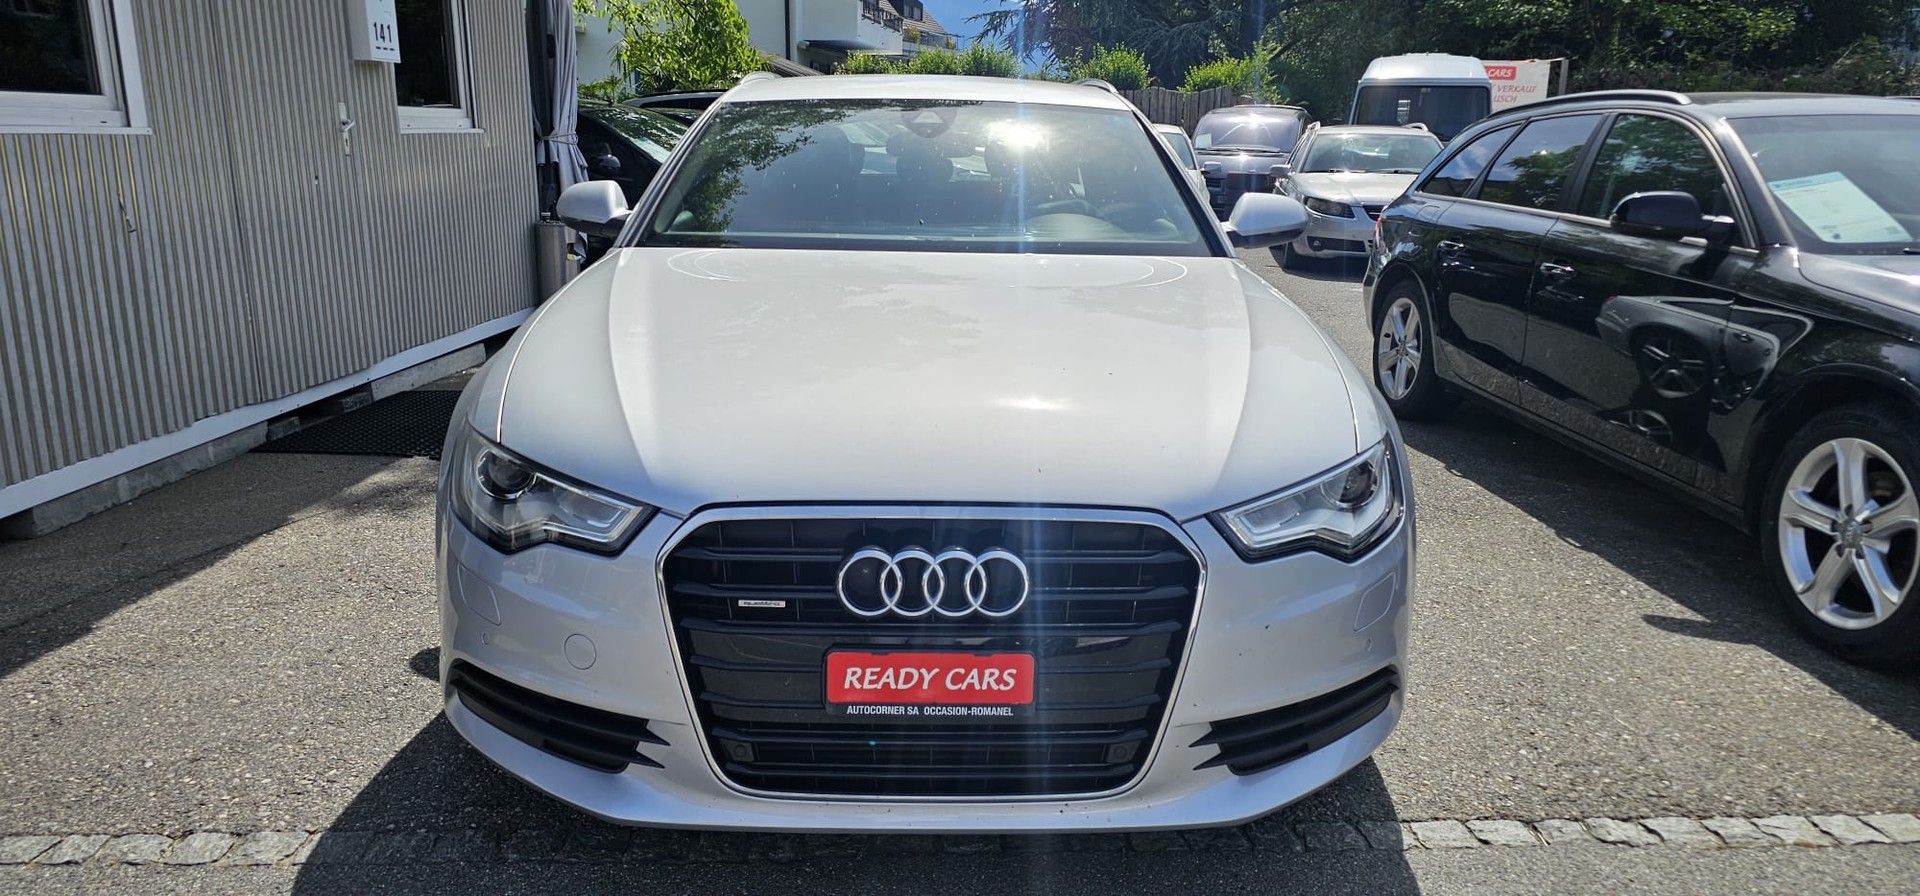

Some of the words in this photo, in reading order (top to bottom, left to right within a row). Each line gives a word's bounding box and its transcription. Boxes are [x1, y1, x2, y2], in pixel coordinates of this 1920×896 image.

[373, 21, 392, 43] 141
[1488, 68, 1512, 77] CARS
[1493, 94, 1517, 103] USCH
[844, 667, 940, 690] READY
[945, 667, 1017, 691] CARS
[846, 705, 905, 716] AUTOCORNER
[907, 706, 919, 716] SA
[924, 706, 1014, 716] OCCASION-ROMANEL
